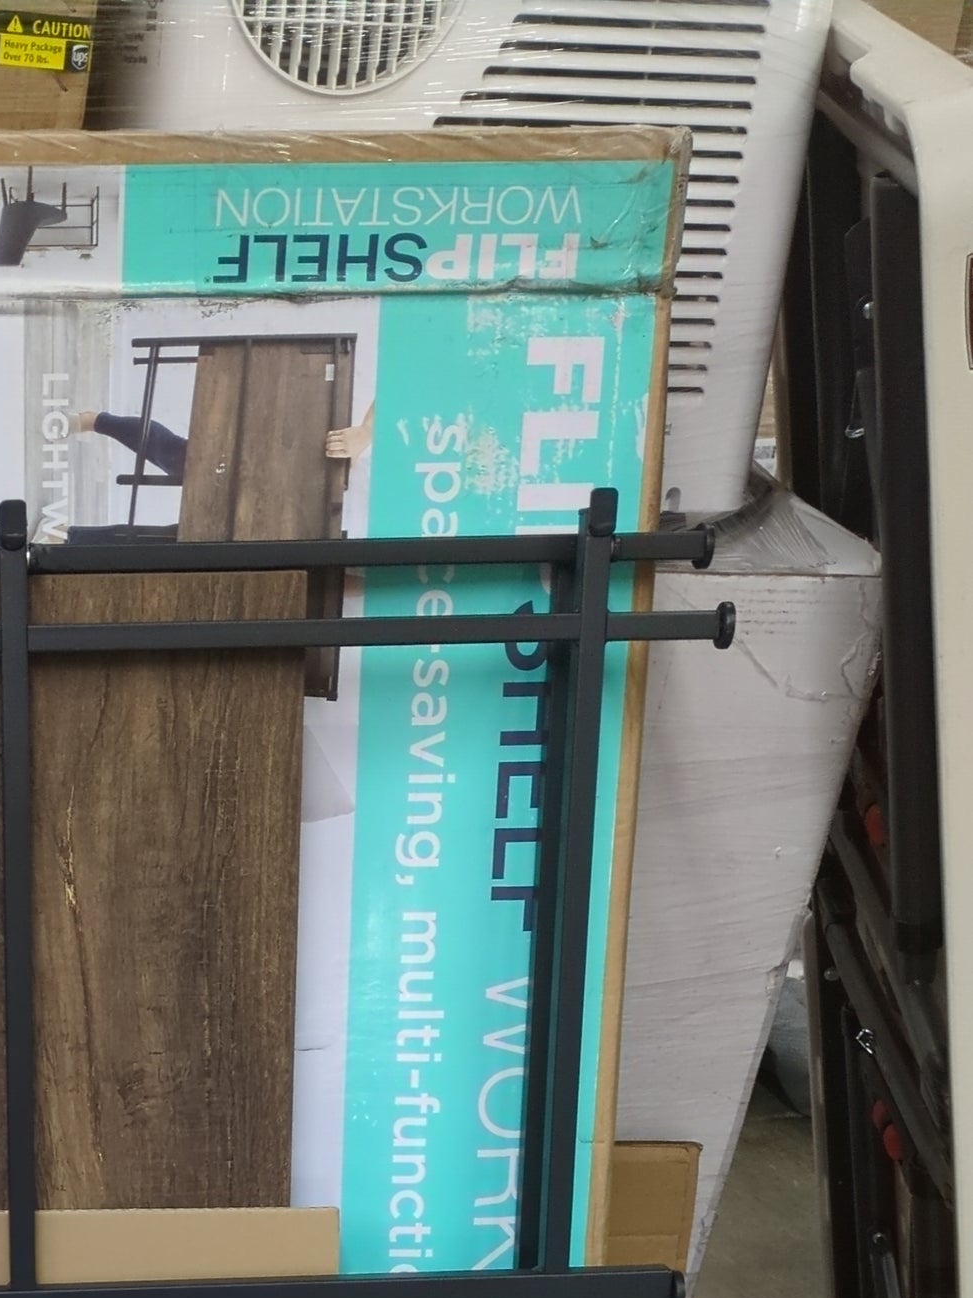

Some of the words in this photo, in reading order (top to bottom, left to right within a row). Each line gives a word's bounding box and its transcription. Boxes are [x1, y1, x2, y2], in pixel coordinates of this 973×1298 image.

[32, 19, 91, 38] CAUTION
[4, 39, 29, 51] Heavy
[31, 41, 63, 53] Package
[3, 52, 21, 62] Over
[24, 53, 34, 63] 70
[36, 54, 50, 64] lbs.
[216, 185, 581, 227] WORKSTATION
